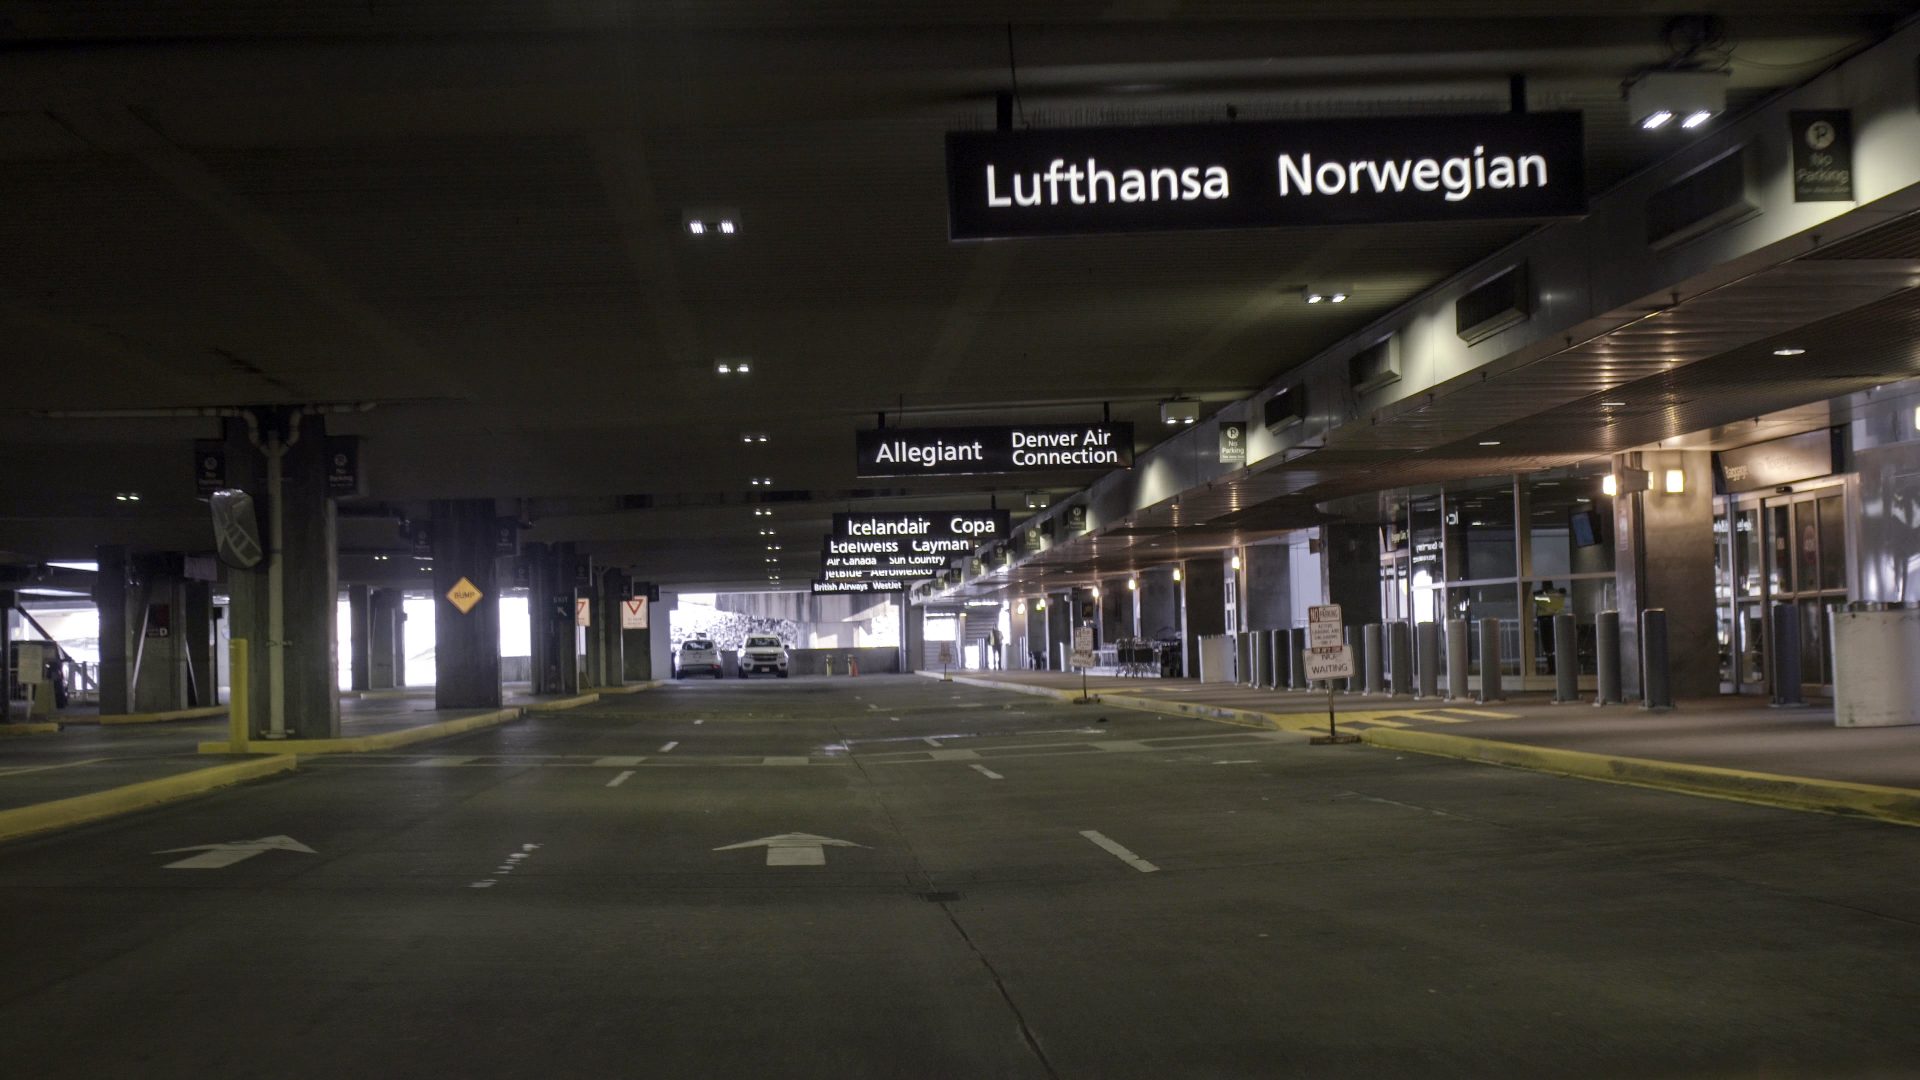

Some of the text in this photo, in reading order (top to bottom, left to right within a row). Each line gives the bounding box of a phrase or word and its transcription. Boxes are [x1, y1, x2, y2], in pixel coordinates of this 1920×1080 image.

[986, 145, 1548, 207] Lufthansa Norwegian
[1012, 428, 1111, 450] Denver Air
[875, 441, 983, 467] Allegiant
[1012, 446, 1118, 466] Connection
[848, 517, 996, 536] Icelandair Copa
[830, 539, 970, 554] Edelweiss Cayman
[826, 556, 946, 566] Air Canada Sun Country
[814, 580, 902, 592] British Airways WestJet
[454, 591, 475, 600] BUMP
[1310, 608, 1318, 622] NO
[1311, 664, 1348, 674] WAITING
